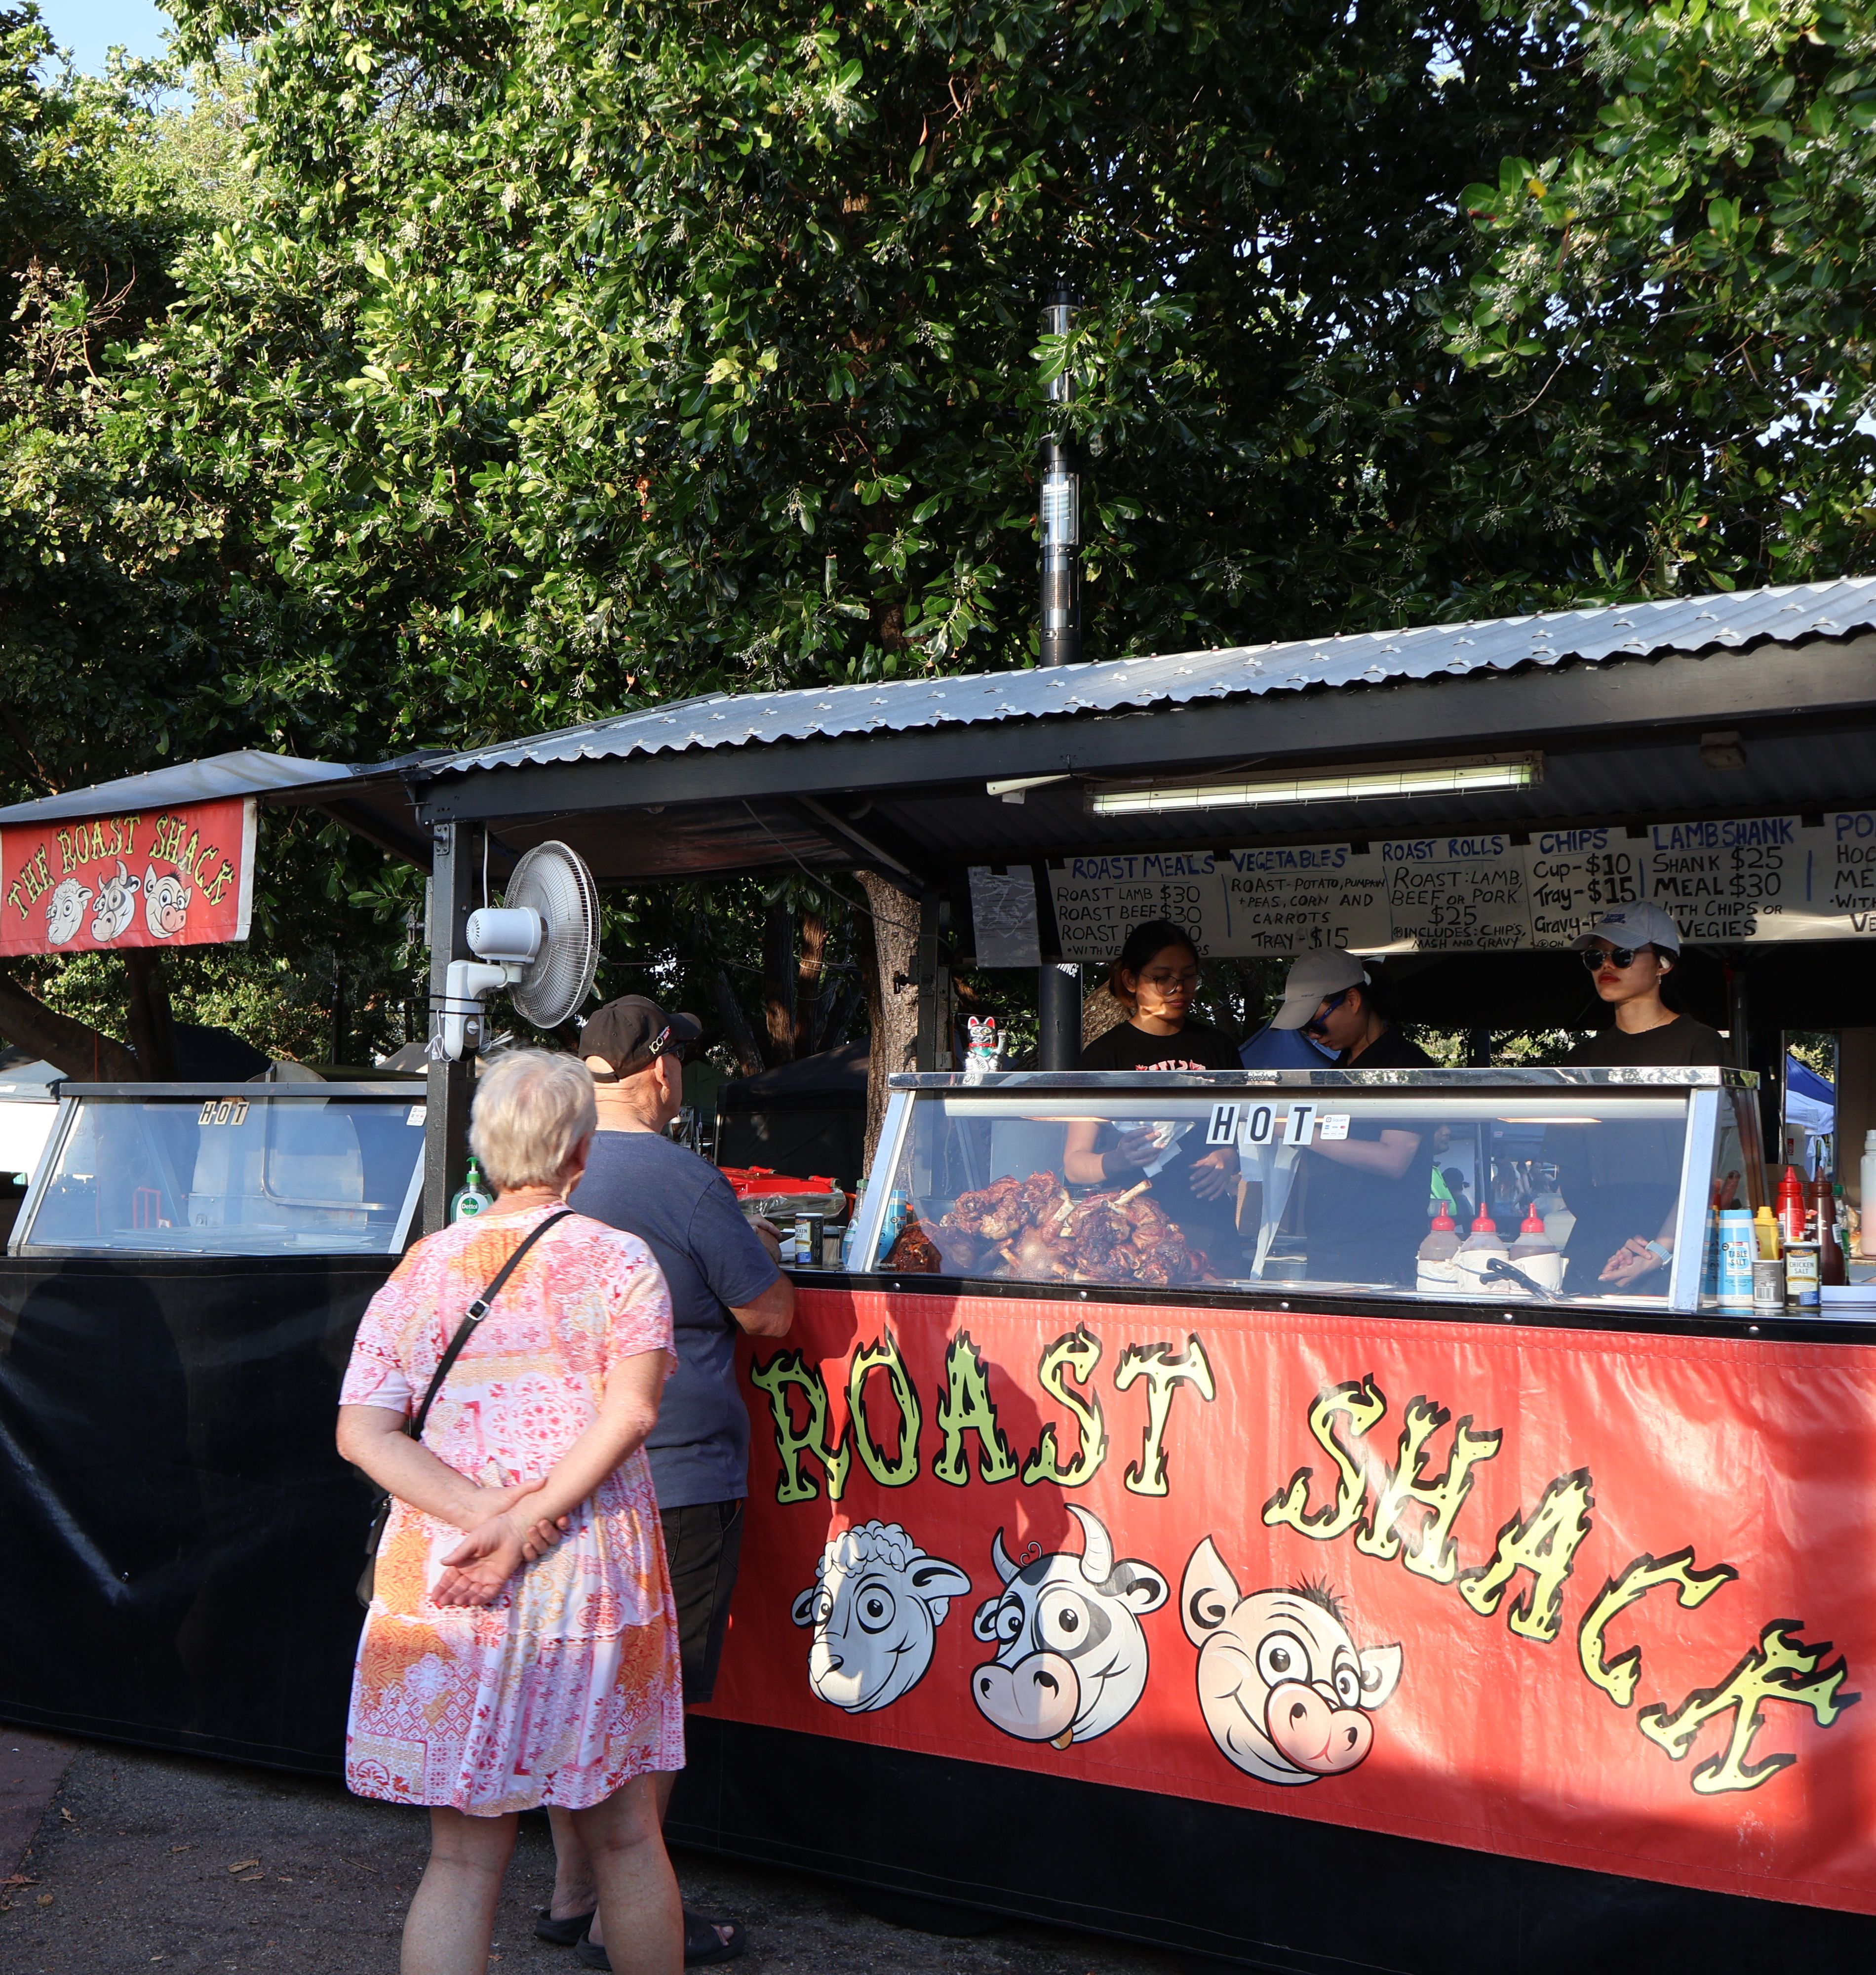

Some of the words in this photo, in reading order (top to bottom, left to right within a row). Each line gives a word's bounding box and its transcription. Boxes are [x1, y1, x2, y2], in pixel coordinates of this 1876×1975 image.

[1836, 813, 1876, 841] PO
[1383, 840, 1437, 862] ROAST
[1448, 836, 1503, 858] ROLLS
[1540, 829, 1609, 854] CHIPS
[1230, 848, 1348, 872] VEGETABLES
[1653, 853, 1720, 873] SHANK
[1730, 846, 1783, 871] $25
[1837, 845, 1876, 864] HOC
[7, 843, 55, 920] THE
[57, 813, 141, 874] ROAST
[149, 812, 235, 906] SHACK
[1072, 857, 1138, 879] ROAST
[1143, 855, 1215, 878] MEALS
[1654, 877, 1723, 897] MEAL
[1729, 872, 1781, 898] $30
[1835, 869, 1876, 889] ME
[1057, 887, 1114, 902] ROAST
[1119, 888, 1153, 902] LAMB
[1160, 884, 1200, 903] $30
[1290, 895, 1329, 907] CORN
[1339, 894, 1373, 907] AND
[1392, 890, 1444, 906] BEEF
[1059, 906, 1115, 921] ROAST
[1120, 905, 1157, 919] BEEF
[1159, 903, 1201, 923] $30
[1428, 905, 1477, 926] $25
[1664, 902, 1697, 915] ITH
[1705, 901, 1759, 915] CHIPS
[1763, 905, 1782, 914] OR
[1253, 912, 1331, 925] CARROTS
[1677, 919, 1758, 938] VEGIES
[1850, 913, 1876, 932] VE
[1062, 925, 1119, 942] ROAST
[1411, 939, 1446, 949] MASH
[1477, 936, 1519, 950] GRAVY
[200, 1104, 247, 1123] HOT
[1212, 1106, 1312, 1142] HOT
[750, 1321, 1215, 1505] ROAST
[1261, 1372, 1862, 1795] SHACK
